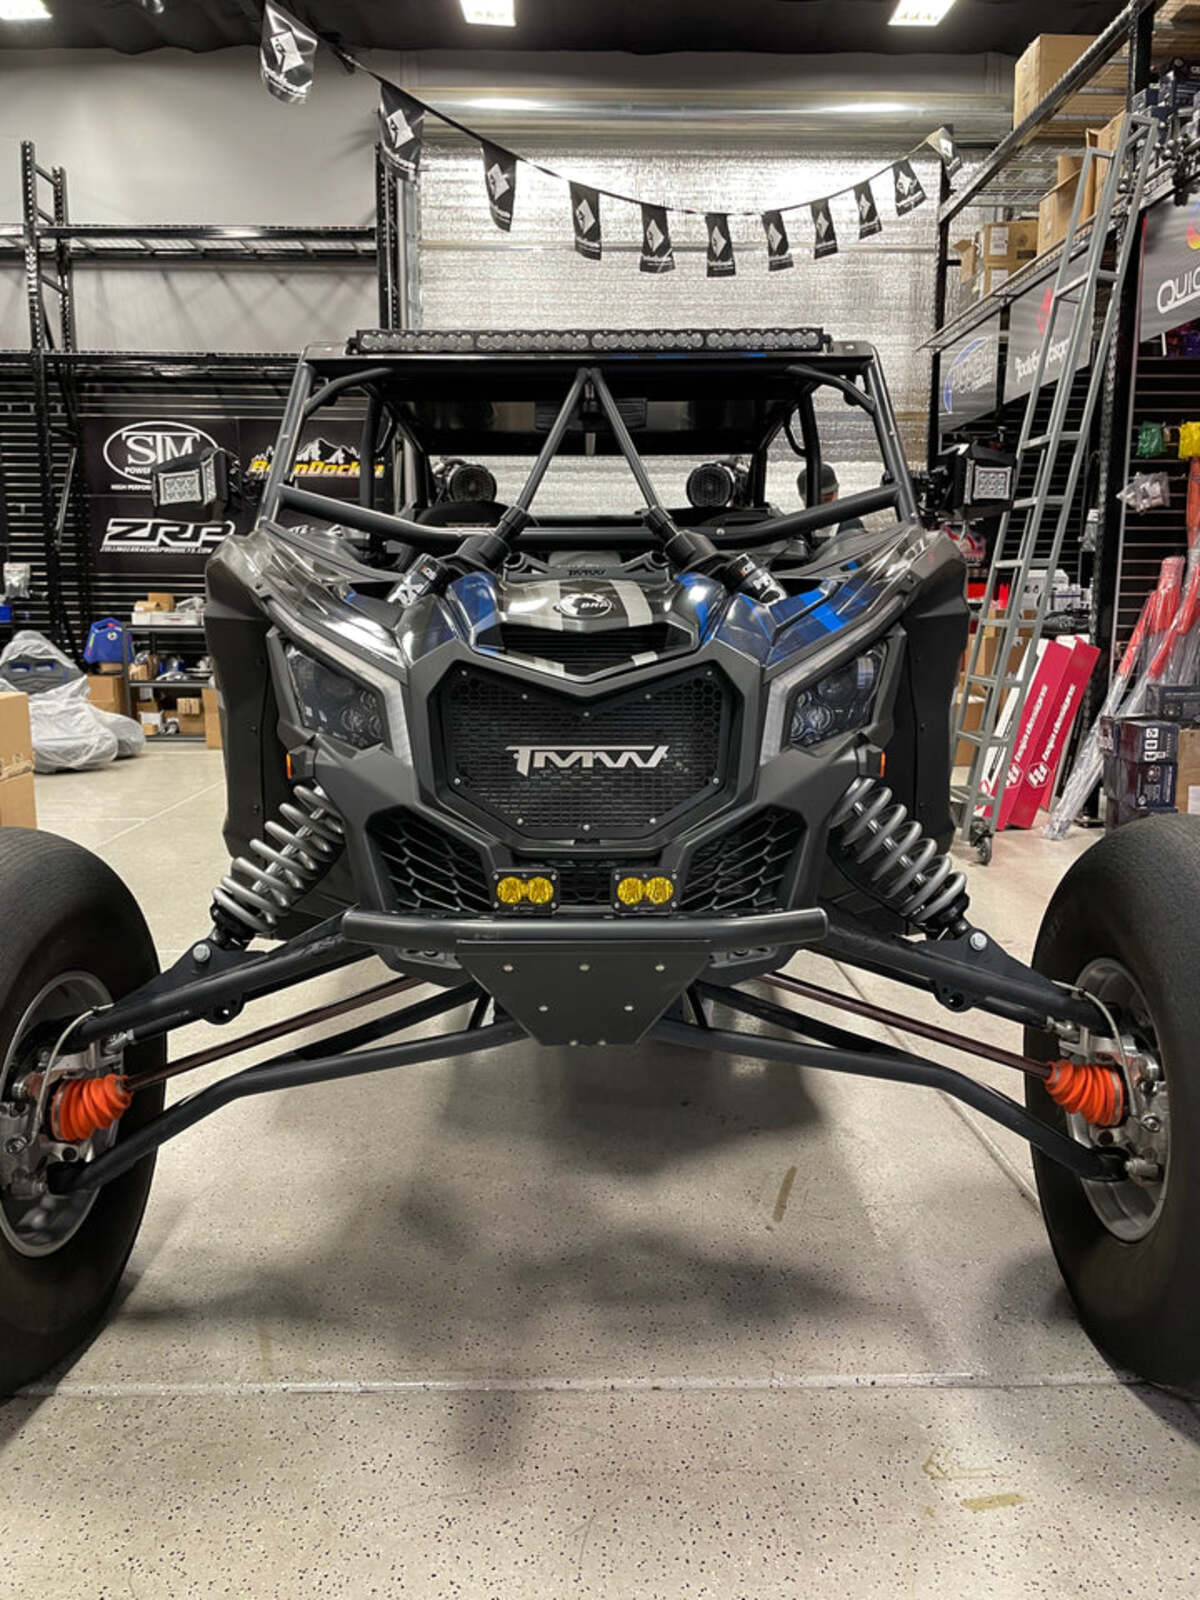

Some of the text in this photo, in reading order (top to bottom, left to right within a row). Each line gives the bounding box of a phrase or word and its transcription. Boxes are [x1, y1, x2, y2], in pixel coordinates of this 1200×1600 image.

[121, 431, 201, 465] STM
[102, 518, 235, 547] ZRP
[505, 745, 669, 777] TMW
